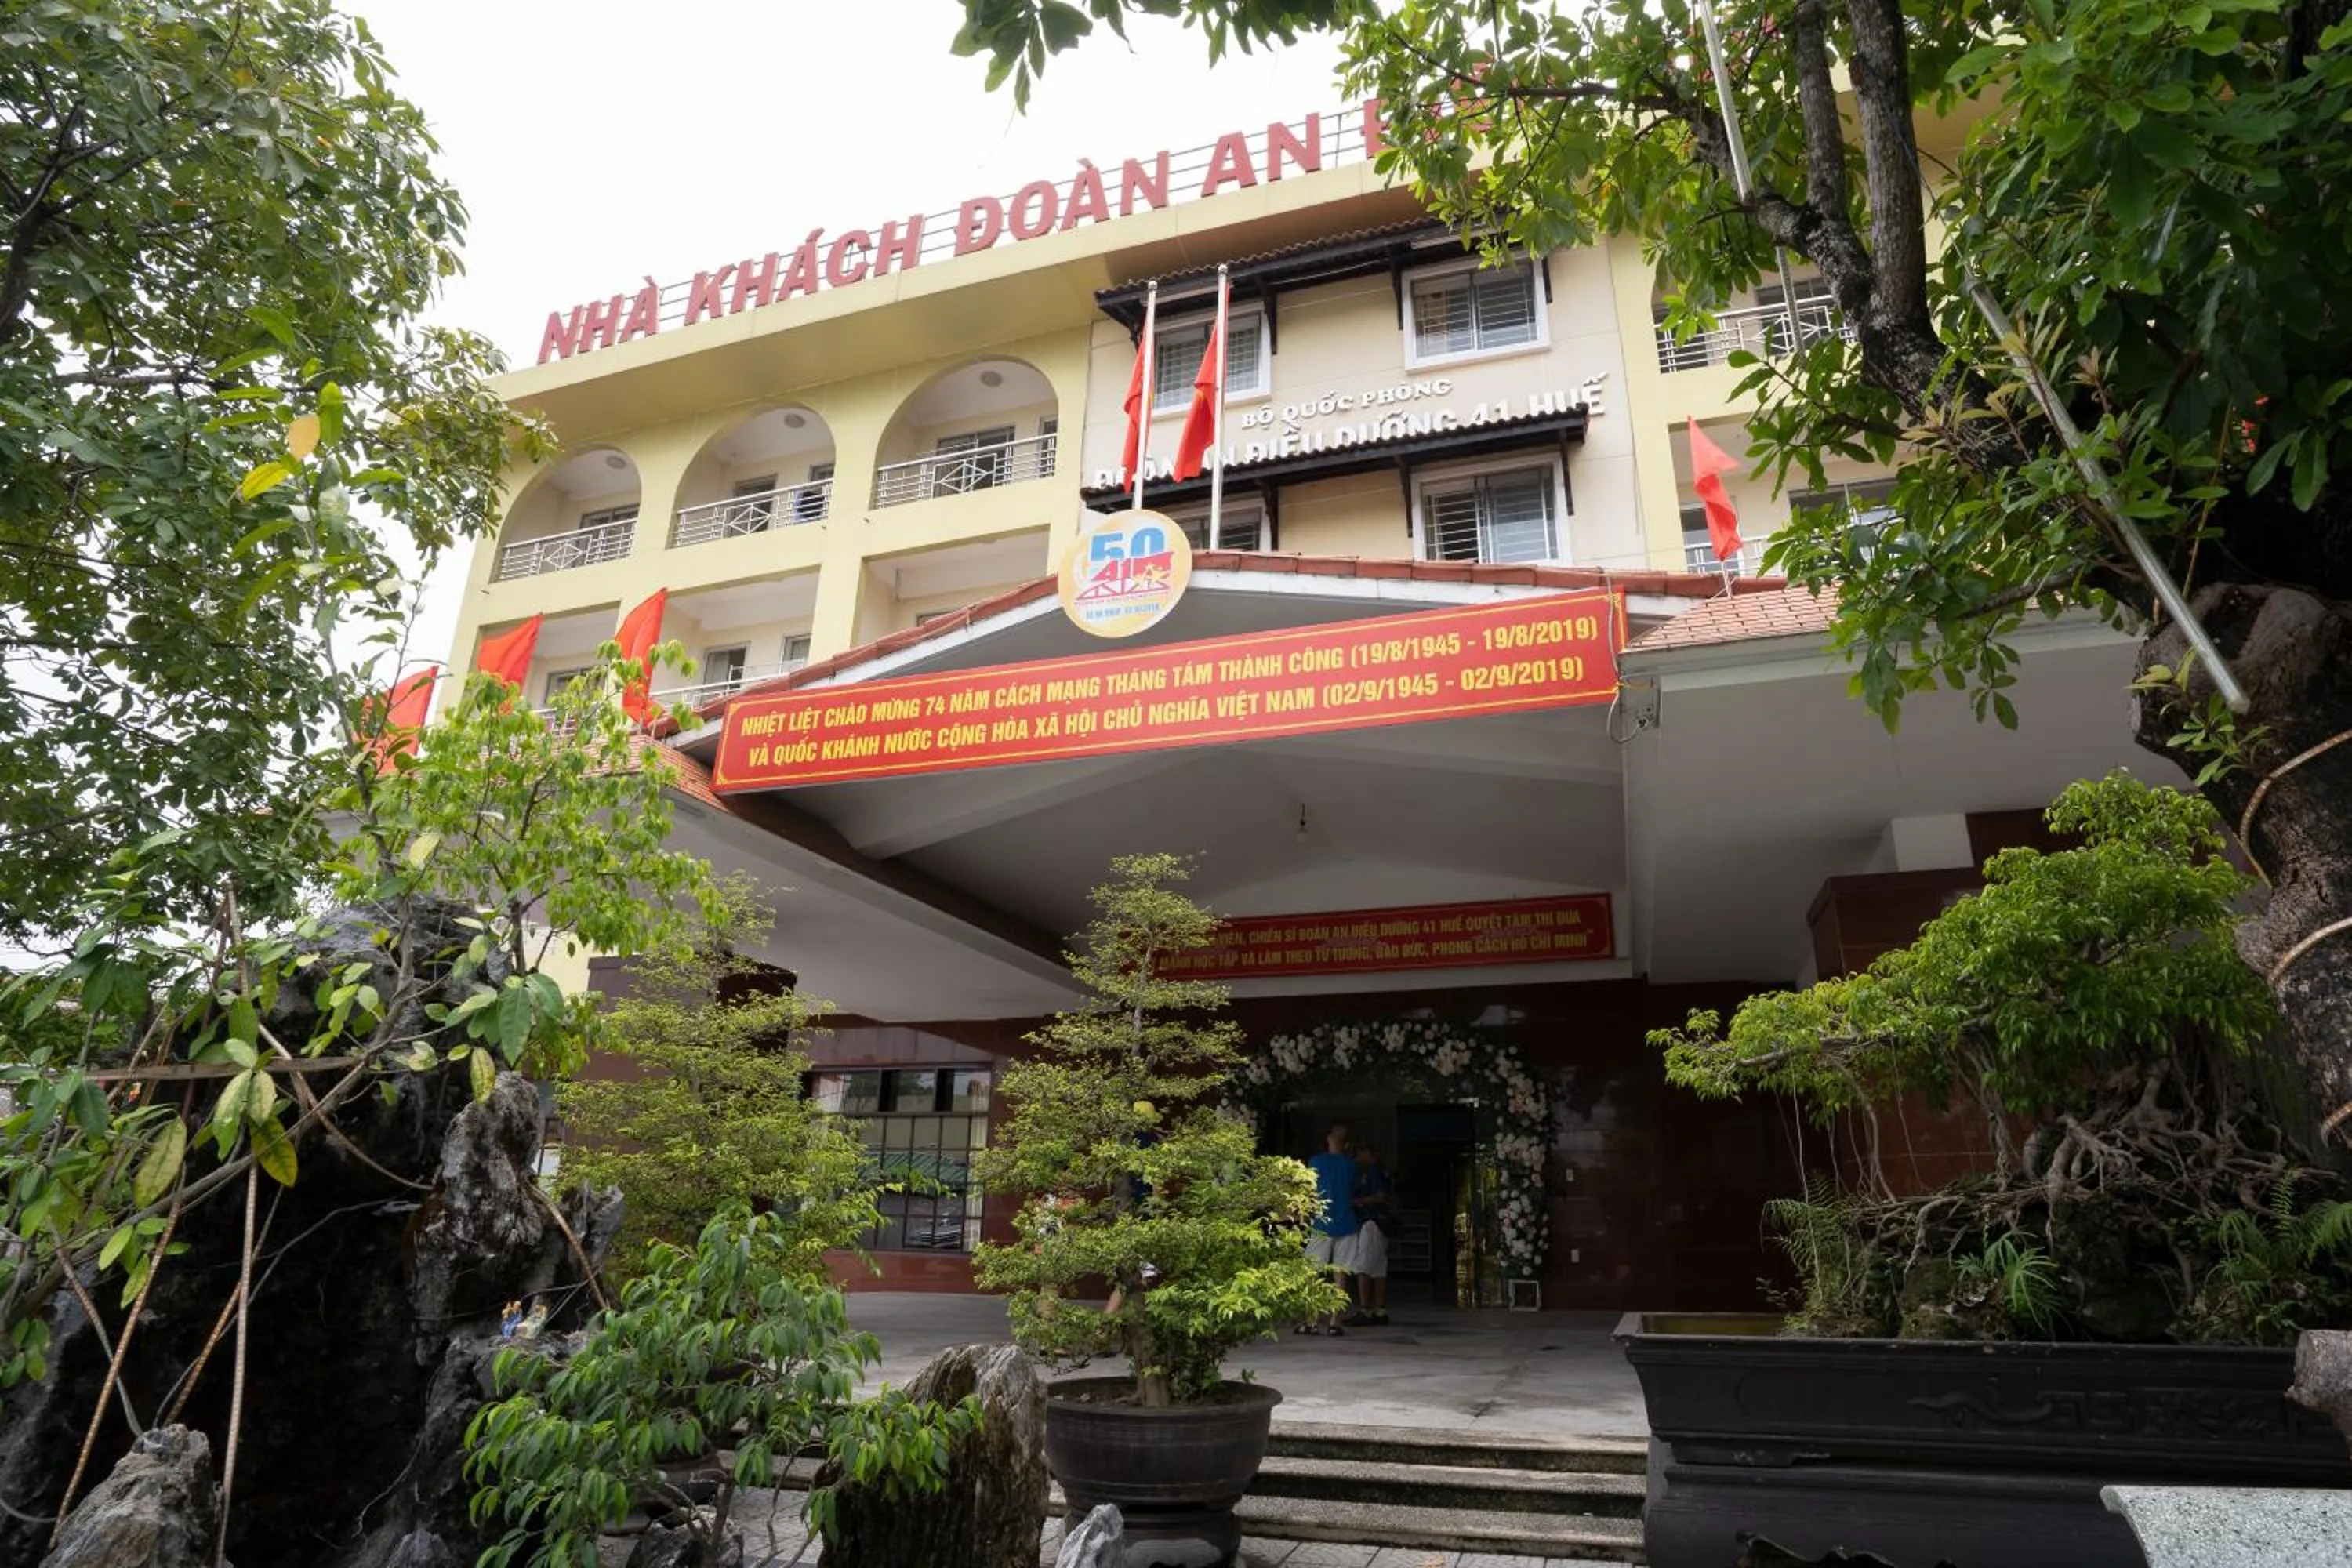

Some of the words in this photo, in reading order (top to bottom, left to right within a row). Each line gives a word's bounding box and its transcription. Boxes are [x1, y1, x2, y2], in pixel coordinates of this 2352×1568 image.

[537, 275, 661, 365] NHÀ
[684, 227, 924, 327] KHÁCH
[953, 149, 1170, 257] ĐOÀN
[1200, 112, 1321, 198] AN
[1241, 408, 1273, 430] BỘ
[1281, 390, 1355, 430] QUỐC
[1359, 379, 1453, 409] PHÒNG
[741, 713, 786, 738] NHIỆT
[788, 706, 822, 734] LIỆT
[824, 702, 868, 728] CHÀO
[871, 698, 921, 722] MỪNG
[925, 695, 946, 716] 74
[949, 688, 990, 713] NĂM
[994, 683, 1042, 708] CÁCH
[1046, 677, 1102, 705] MẠNG
[1105, 667, 1167, 696] THÁNG
[1172, 661, 1214, 688] TÁM
[1218, 653, 1283, 683] THÀNH
[1287, 646, 1345, 675] CÔNG
[1350, 632, 1461, 669] (19/8/1945
[1482, 615, 1598, 651] 19/8/2019)
[749, 742, 769, 767] VÀ
[773, 739, 818, 766] QUỐC
[821, 735, 880, 760] KHÁNH
[884, 727, 932, 753] NƯỚC
[937, 722, 987, 751] CỘNG
[991, 717, 1029, 742] HÒA
[1033, 711, 1059, 739] XÃ
[1064, 708, 1098, 738] HỘI
[1102, 699, 1144, 731] CHỦ
[1148, 691, 1211, 725] NGHĨA
[1215, 688, 1260, 721] VIỆT
[1265, 685, 1316, 713] NAM
[1322, 672, 1439, 709] (02/9/1945
[1461, 656, 1583, 691] 02/9/2019)
